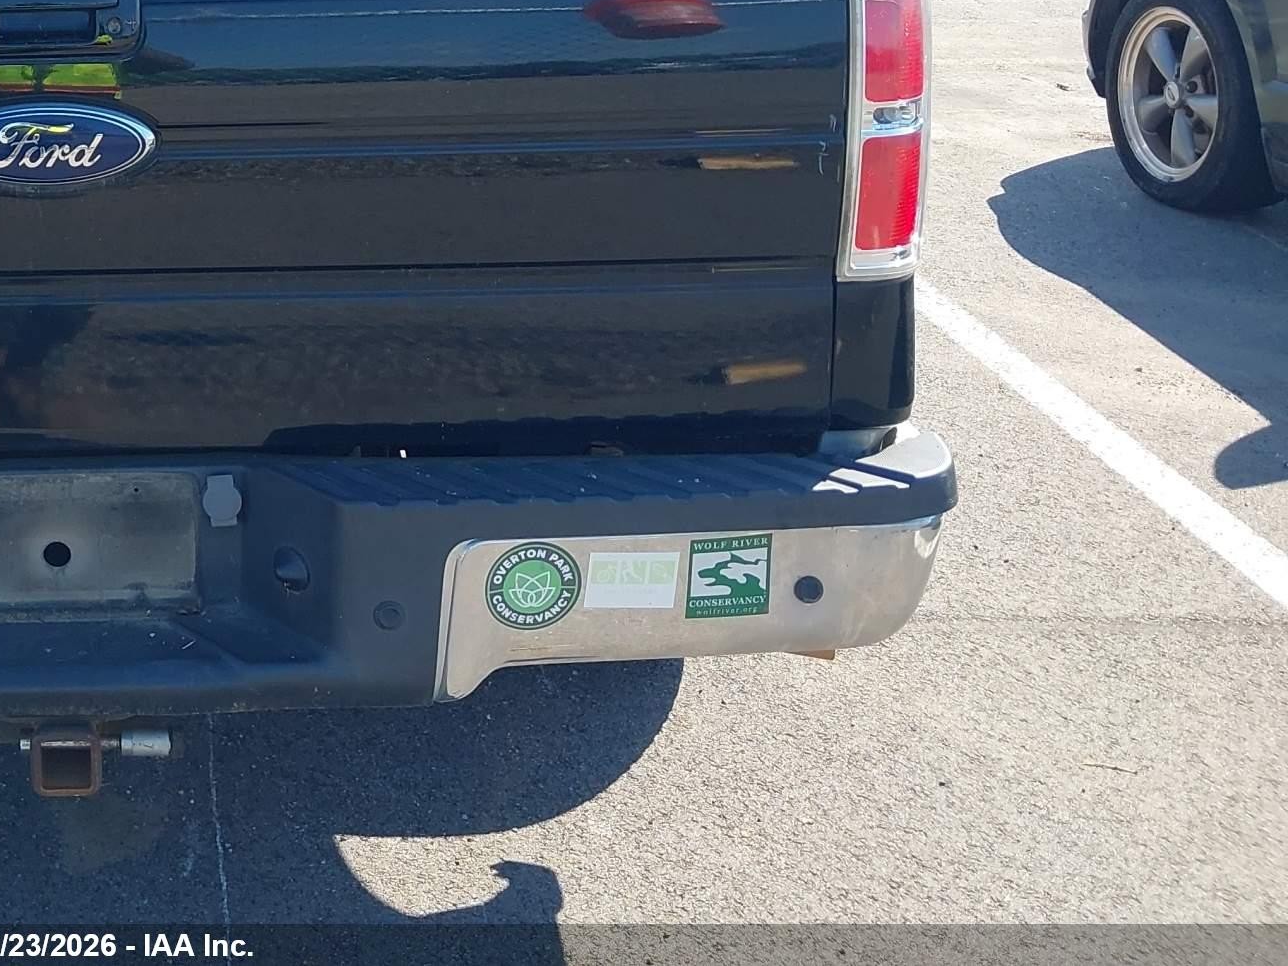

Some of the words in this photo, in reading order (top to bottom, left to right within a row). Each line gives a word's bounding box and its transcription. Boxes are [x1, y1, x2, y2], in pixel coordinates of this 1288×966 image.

[693, 541, 727, 551] WOLF
[731, 537, 769, 548] RIVER
[493, 548, 547, 585] OVERTON
[548, 553, 575, 582] PARK
[492, 590, 572, 624] CONSERVANCY
[689, 595, 767, 608] CONSERVANCY
